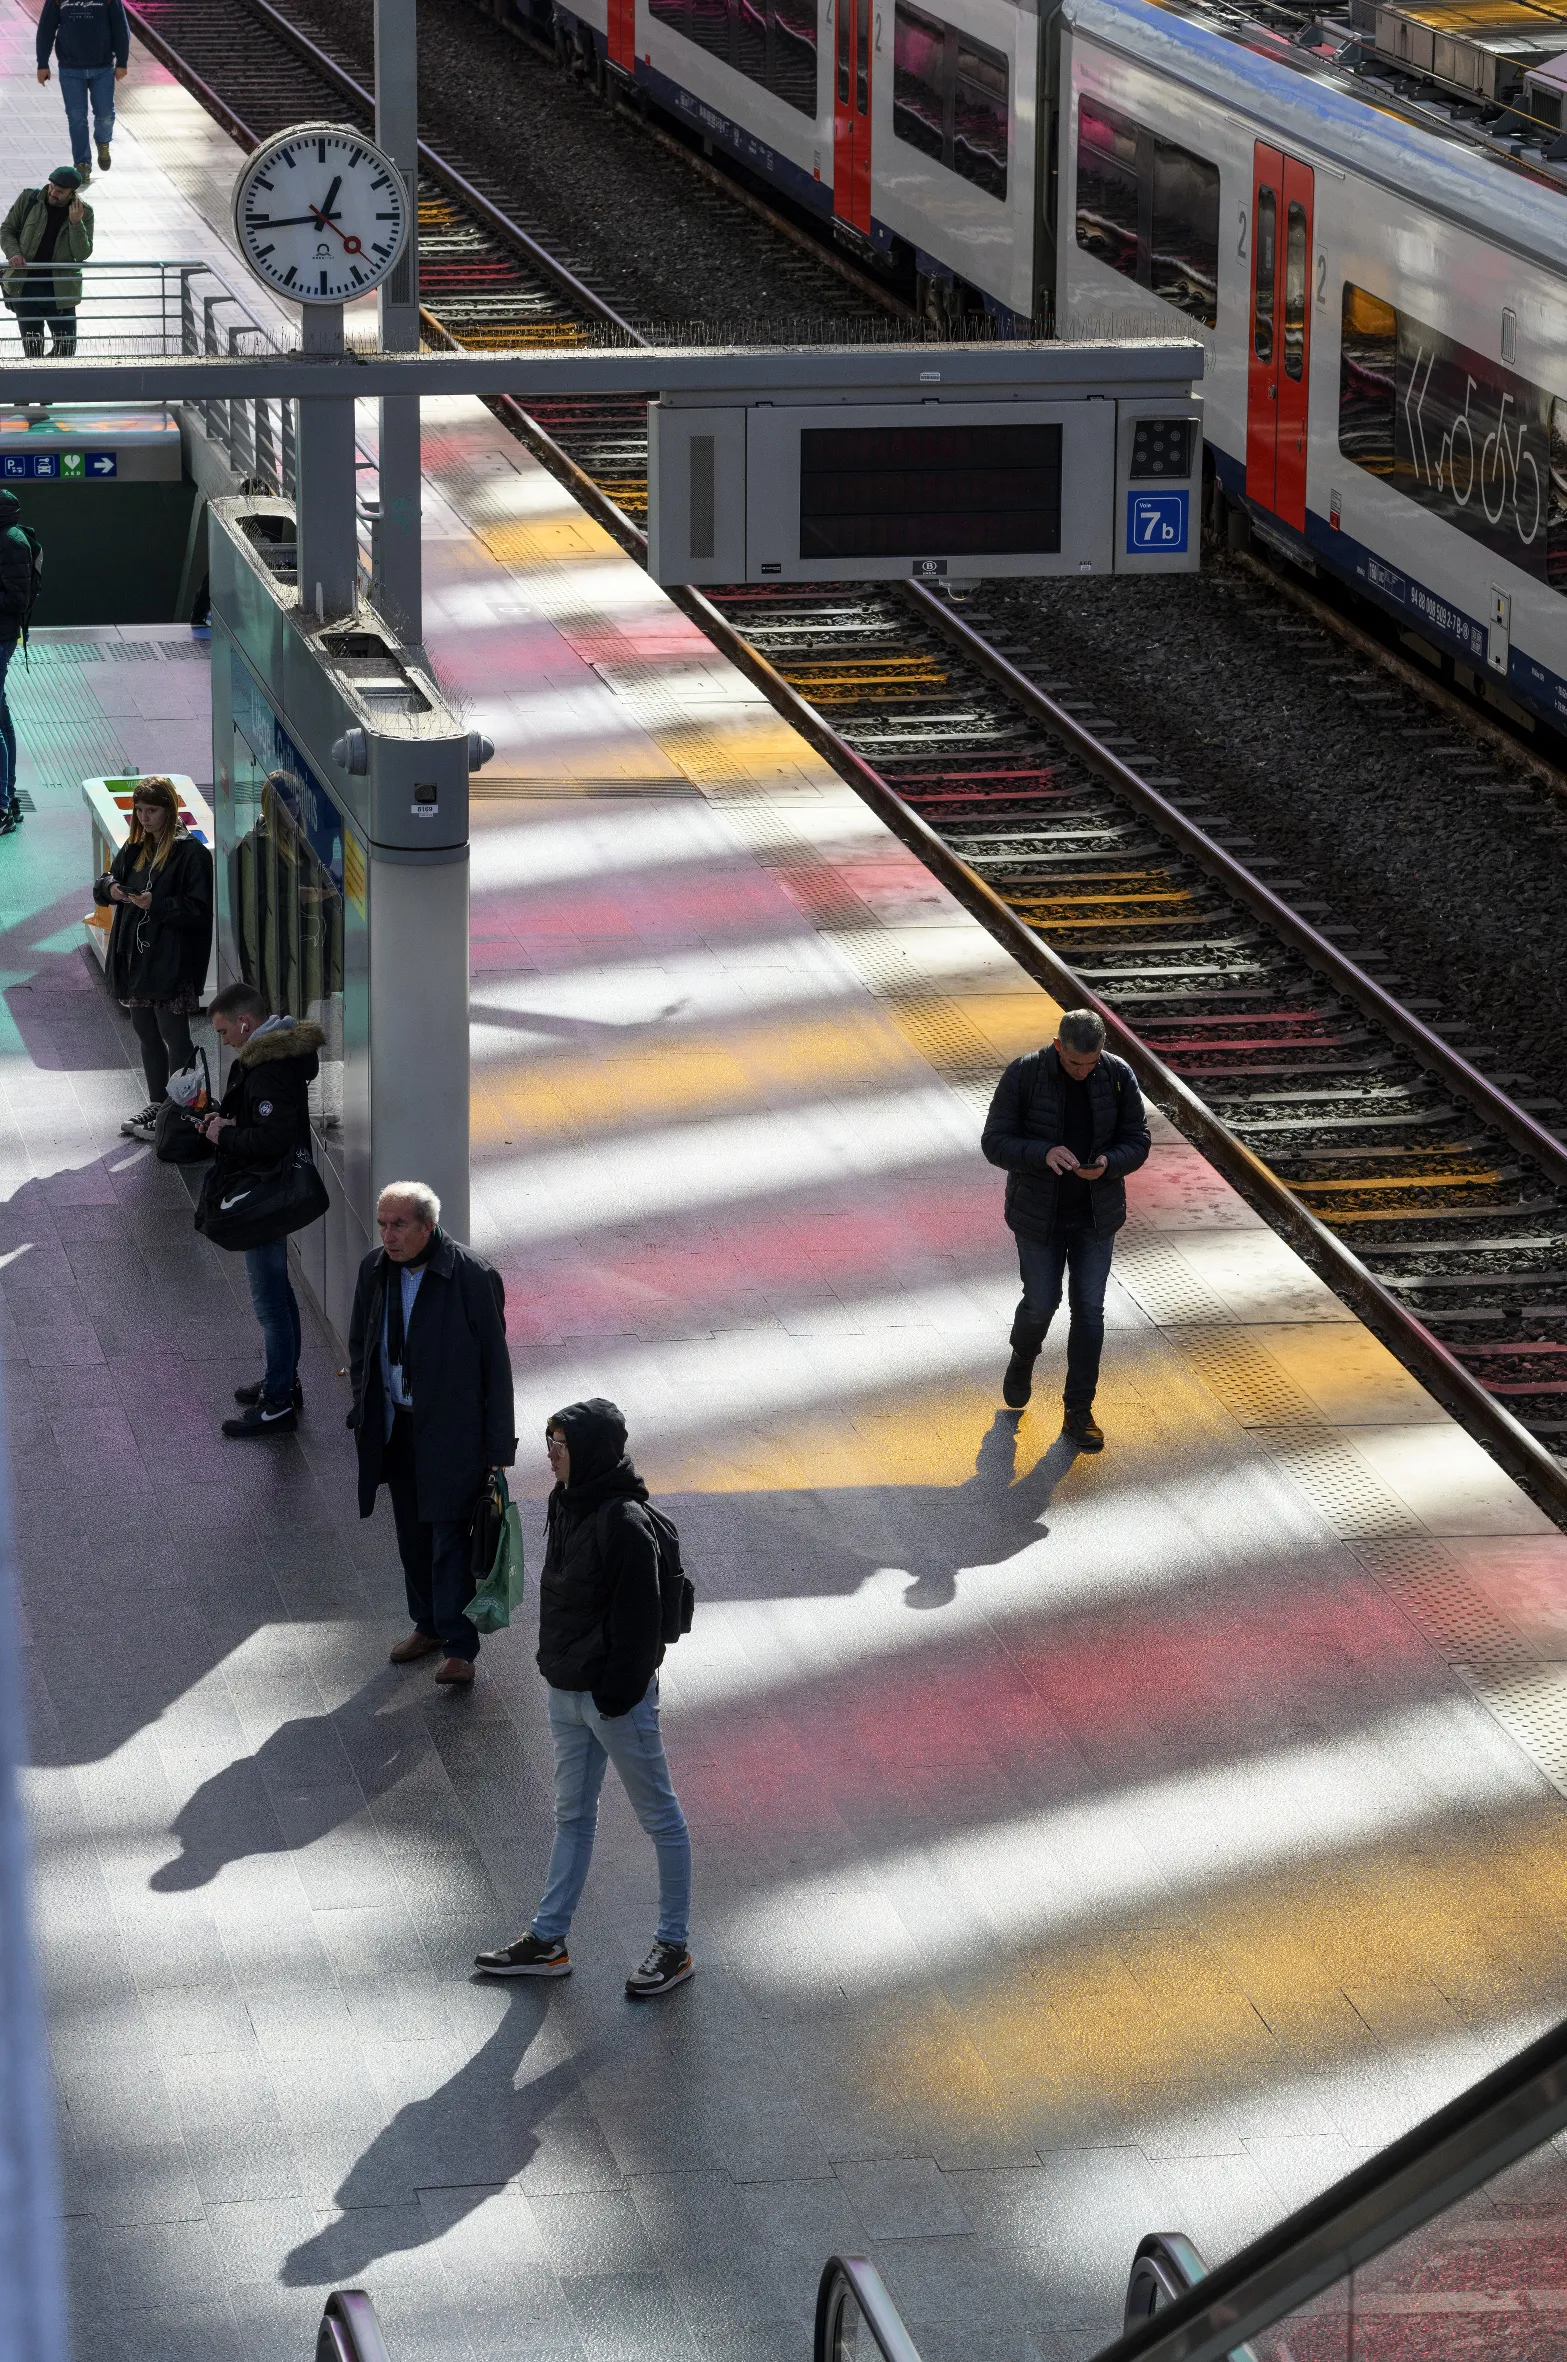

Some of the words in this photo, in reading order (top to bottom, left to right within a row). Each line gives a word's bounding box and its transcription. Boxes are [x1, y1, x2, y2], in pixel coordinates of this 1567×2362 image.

[875, 12, 882, 52] 2
[1238, 210, 1247, 260] 2
[1316, 254, 1327, 305] 2
[7, 460, 15, 469] P
